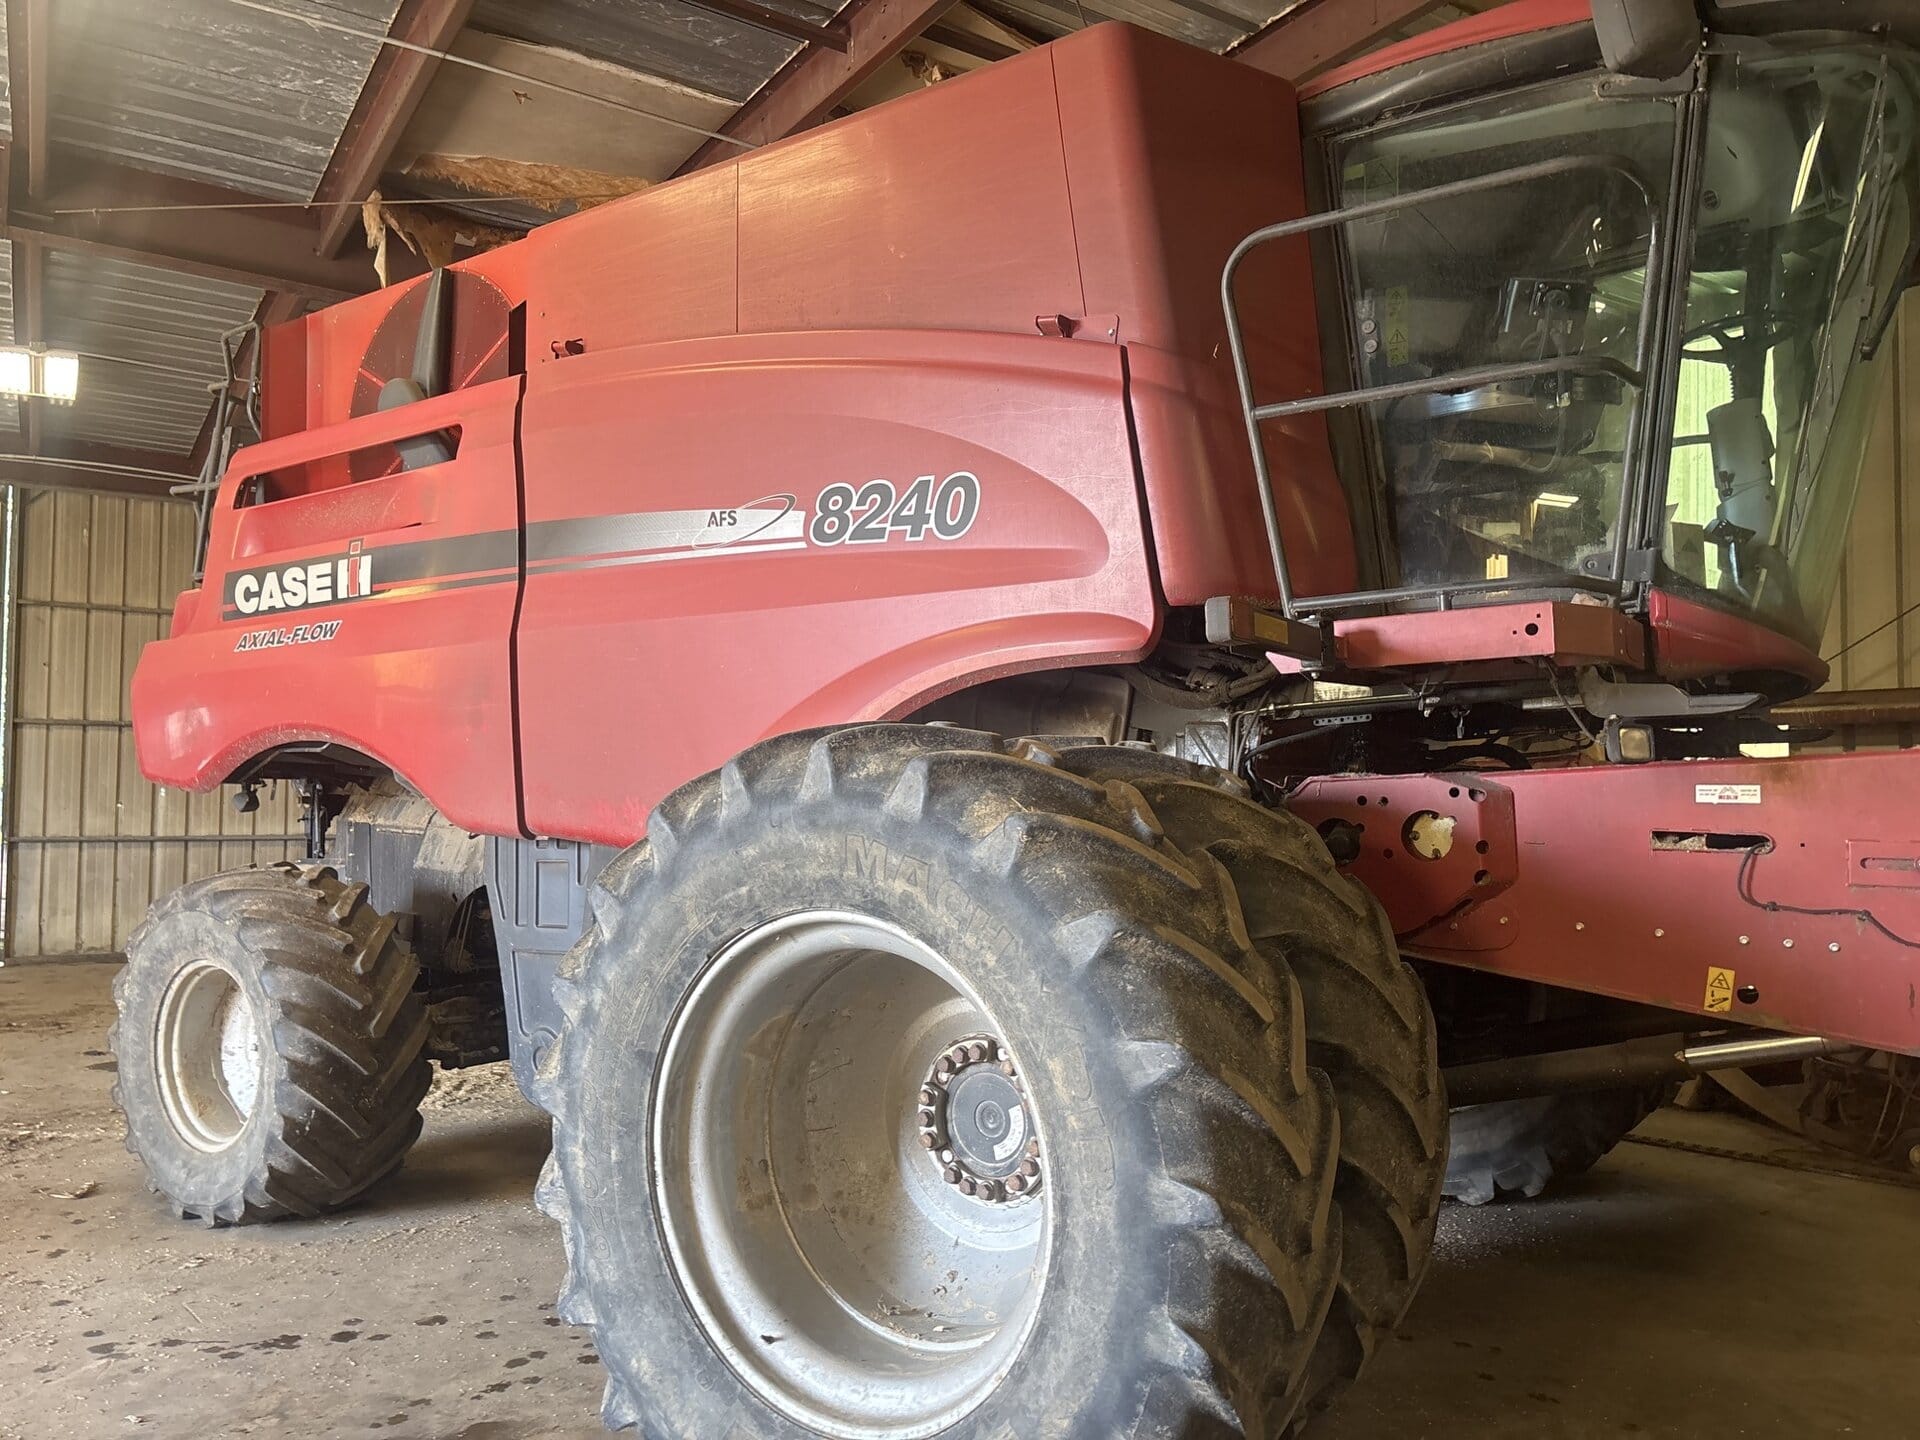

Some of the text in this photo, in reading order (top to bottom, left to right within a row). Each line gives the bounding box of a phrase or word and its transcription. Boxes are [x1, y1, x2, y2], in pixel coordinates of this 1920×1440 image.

[707, 510, 738, 527] AFS
[809, 471, 981, 547] 8240
[234, 562, 333, 614] CASE
[235, 620, 341, 651] AXIAL-FLOW
